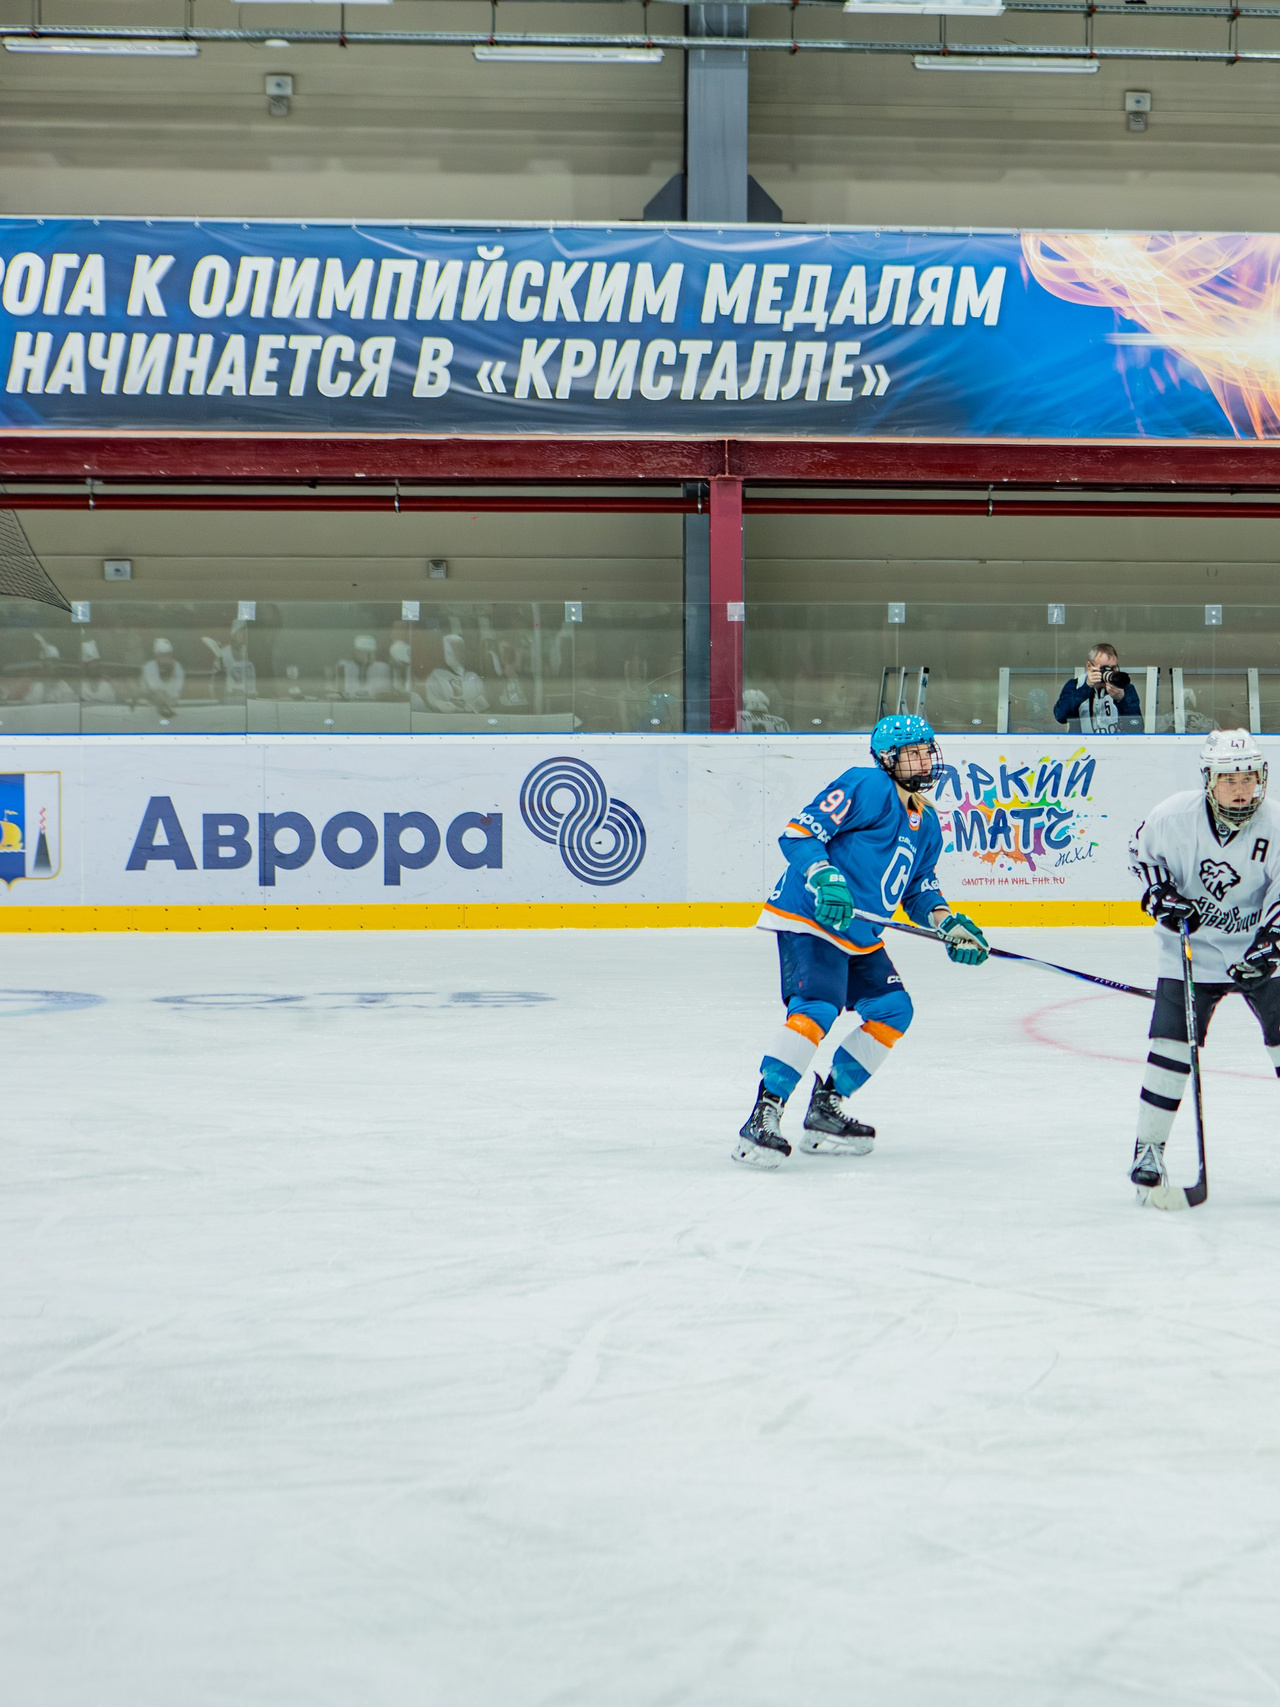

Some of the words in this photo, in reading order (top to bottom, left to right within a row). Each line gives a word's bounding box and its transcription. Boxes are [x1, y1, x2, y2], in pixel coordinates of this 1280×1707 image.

[0, 252, 104, 317] ОГА
[127, 254, 176, 317] К
[189, 245, 684, 324] ОЛИМПИЙСКИМ
[700, 262, 1007, 332] МЕДАЛЯМ
[6, 331, 396, 397] НАЧИНАЕТСЯ
[412, 336, 452, 398] В
[476, 338, 891, 401] «КРИСТАЛЛЕ»
[1231, 738, 1246, 749] 47
[819, 789, 852, 825] 91
[125, 795, 503, 887] Аврора
[961, 877, 996, 886] СМОТРИ
[998, 877, 1010, 885] НА
